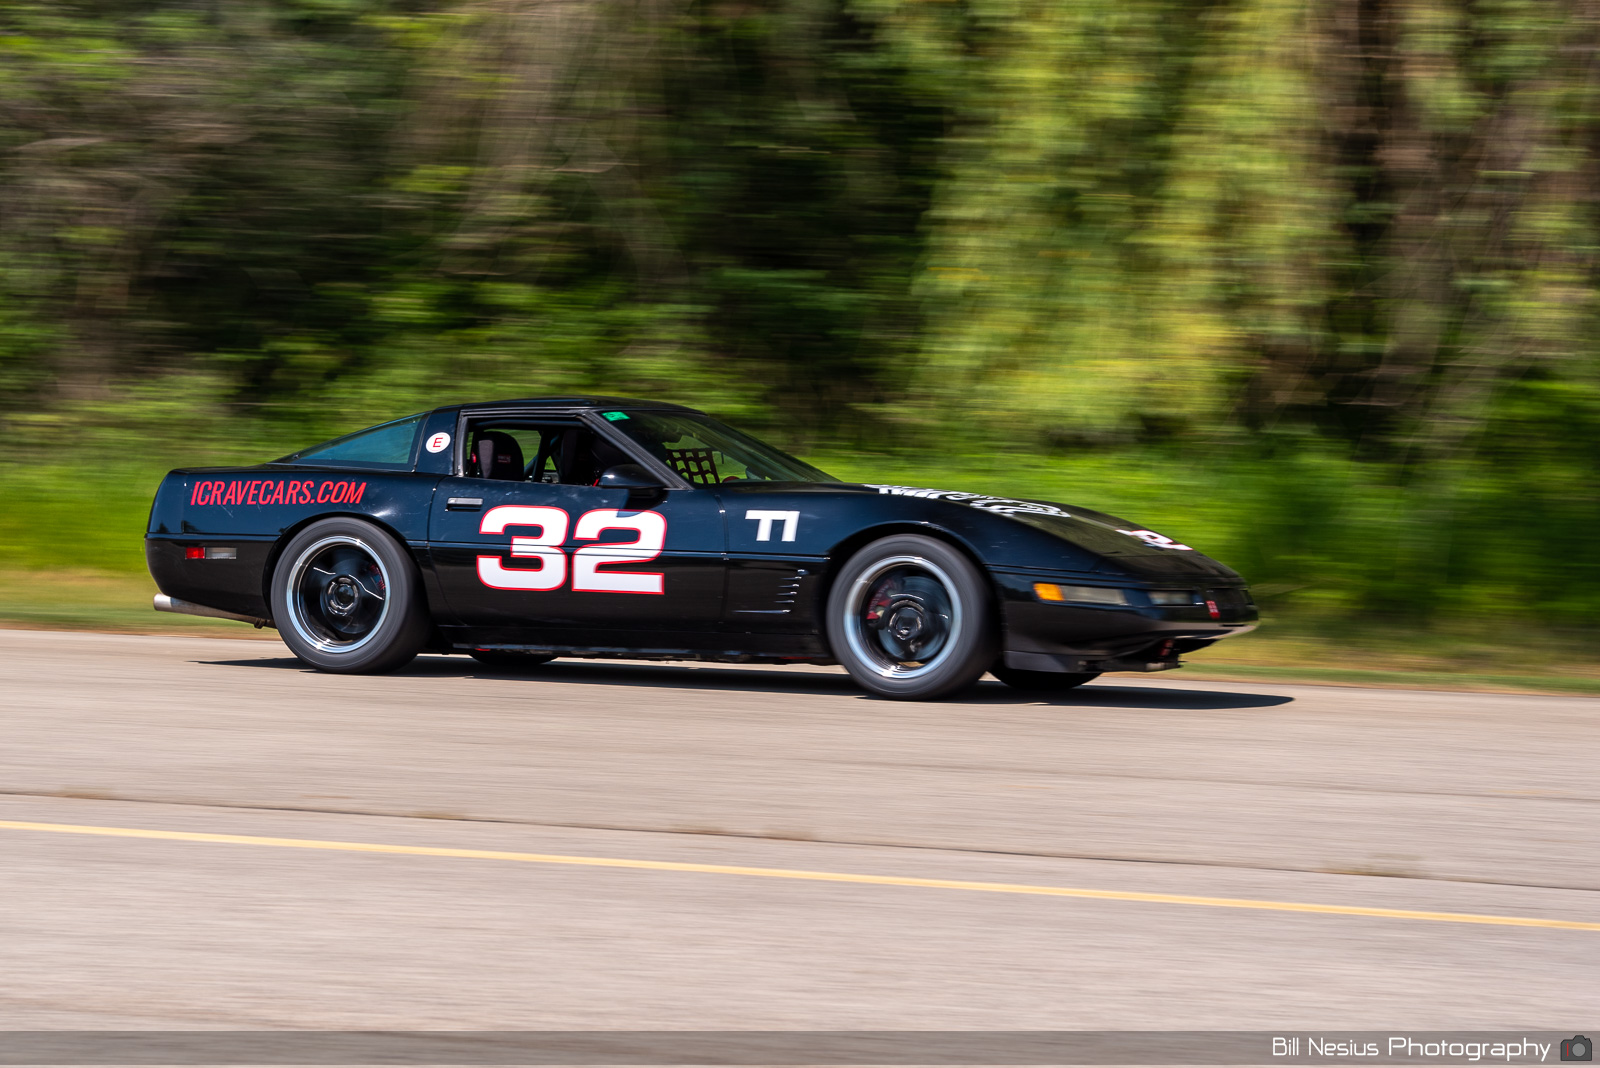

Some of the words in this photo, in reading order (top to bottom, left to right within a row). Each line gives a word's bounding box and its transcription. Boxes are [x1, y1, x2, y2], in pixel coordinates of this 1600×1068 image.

[432, 437, 444, 448] E
[190, 481, 367, 506] ICRAVECARS.COM
[477, 505, 667, 595] 32
